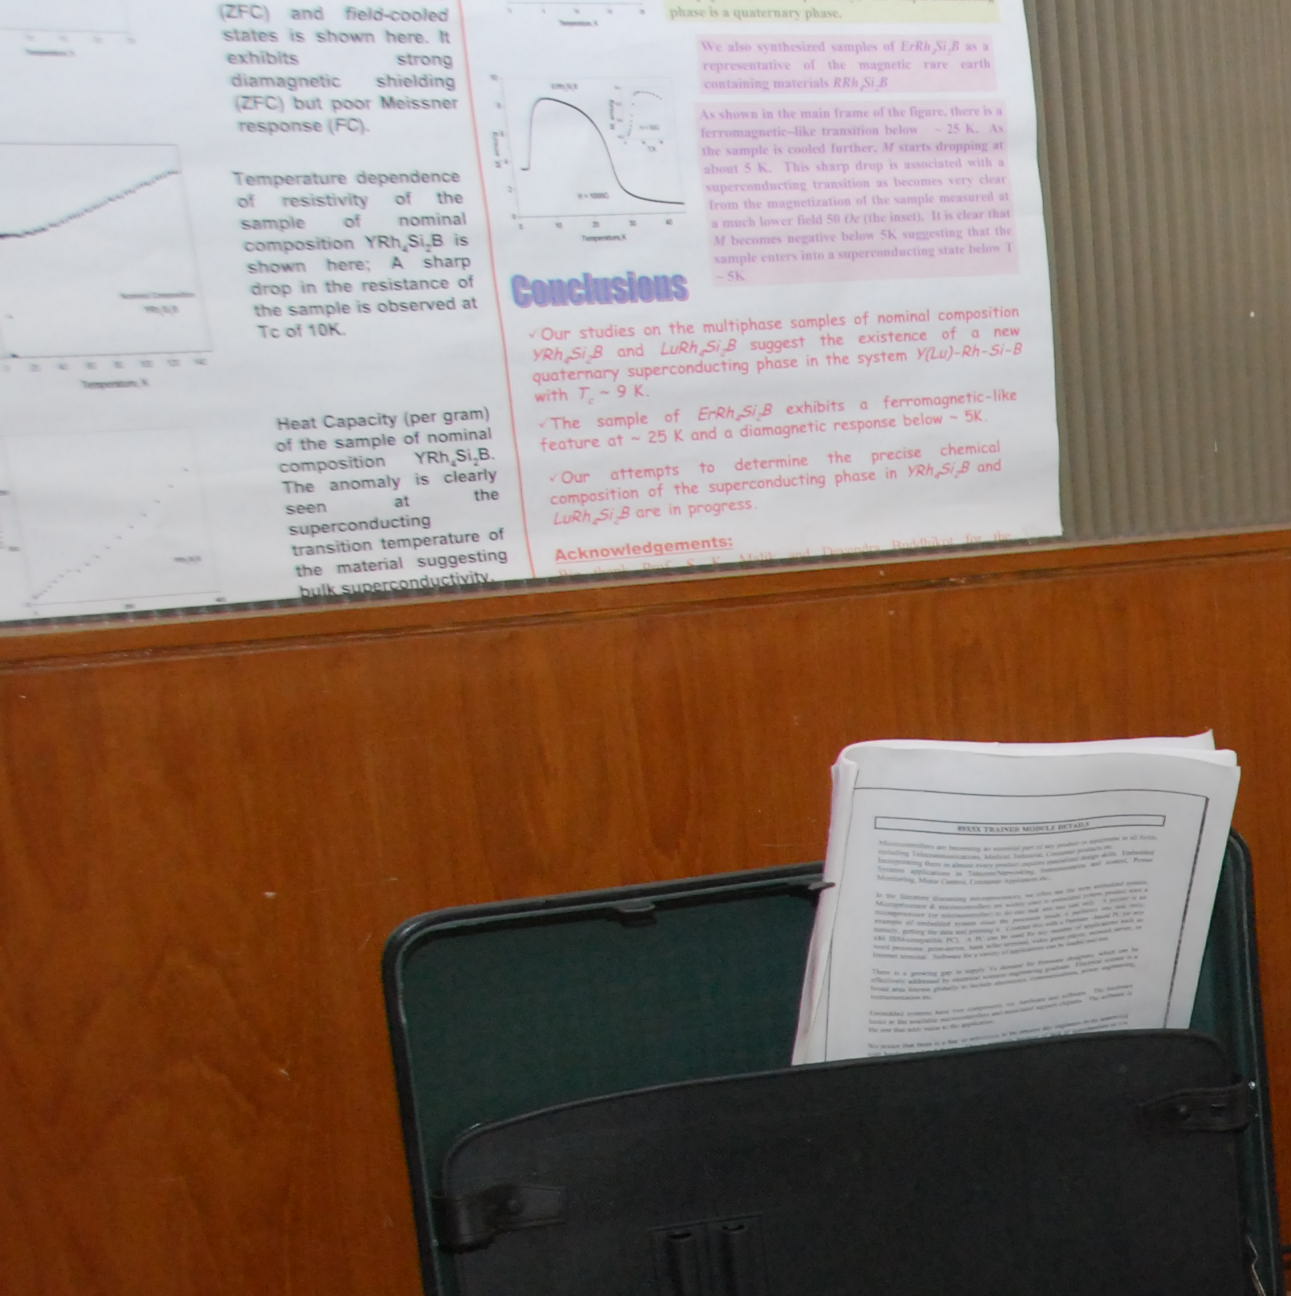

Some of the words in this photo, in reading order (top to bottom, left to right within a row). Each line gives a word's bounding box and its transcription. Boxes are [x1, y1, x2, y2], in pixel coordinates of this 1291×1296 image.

[218, 4, 270, 22] (ZFC)
[290, 6, 325, 21] and
[344, 6, 449, 22] field-cooled
[669, 6, 706, 21] phase
[709, 6, 720, 18] is
[722, 9, 730, 18] a
[733, 8, 801, 21] quaternary
[804, 7, 842, 22] phase.
[222, 29, 279, 43] states
[289, 29, 306, 43] is
[315, 29, 375, 43] shown
[385, 30, 429, 44] here.
[439, 30, 451, 44] It
[226, 50, 300, 66] exhibits
[395, 52, 453, 70] strong
[230, 73, 341, 92] diamagnetic
[376, 74, 456, 92] shielding
[234, 95, 284, 113] (ZFC)
[292, 96, 323, 110] but
[331, 99, 372, 113] poor
[380, 96, 458, 110] Meissner
[237, 121, 322, 136] response
[327, 117, 370, 136] (FC).
[233, 170, 347, 189] Temperature
[355, 170, 461, 187] dependence
[236, 194, 255, 208] of
[282, 193, 368, 210] resistivity
[394, 191, 411, 205] of
[436, 191, 464, 205] the
[240, 216, 306, 232] sample
[343, 214, 361, 228] of
[398, 212, 467, 227] nominal
[244, 237, 355, 254] composition
[454, 233, 469, 246] is
[246, 260, 306, 274] shown
[326, 258, 370, 271] here;
[391, 256, 404, 269] A
[423, 255, 471, 271] sharp
[250, 282, 292, 298] drop
[300, 281, 317, 294] in
[324, 280, 353, 293] the
[361, 278, 450, 292] resistance
[457, 274, 474, 288] of
[511, 271, 689, 308] Conclusions
[254, 304, 282, 317] the
[287, 301, 351, 318] sample
[356, 300, 372, 313] is
[376, 297, 456, 313] observed
[462, 297, 478, 310] at
[258, 324, 280, 339] Tc
[285, 324, 303, 338] of
[308, 322, 346, 336] 10K.
[540, 327, 571, 341] Our
[579, 324, 636, 339] studies
[643, 326, 661, 336] on
[668, 321, 695, 334] the
[703, 317, 783, 335] multiphase
[790, 313, 846, 331] samples
[854, 311, 869, 326] of
[877, 309, 930, 324] nominal
[938, 306, 1019, 324] composition
[617, 343, 645, 358] and
[750, 336, 806, 354] suggest
[820, 333, 844, 347] the
[858, 331, 927, 344] existence
[941, 326, 957, 340] of
[971, 329, 980, 339] a
[994, 328, 1021, 338] new
[532, 368, 620, 386] quaternary
[627, 360, 749, 380] superconducting
[756, 356, 798, 374] phase
[806, 354, 819, 367] in
[825, 352, 850, 366] the
[857, 351, 907, 367] system
[534, 388, 568, 403] with
[617, 384, 627, 398] 9
[633, 384, 649, 397] K.
[276, 417, 318, 430] Heat
[322, 413, 398, 430] Capacity
[403, 412, 437, 427] (per
[443, 406, 490, 425] gram)
[550, 416, 581, 430] The
[597, 411, 648, 429] sample
[664, 408, 680, 423] of
[786, 400, 845, 415] exhibits
[860, 400, 868, 410] a
[883, 389, 1017, 409] ferromagnetic-like
[275, 438, 292, 452] of
[299, 438, 327, 451] the
[334, 434, 396, 450] sample
[403, 431, 420, 445] of
[427, 427, 492, 443] nominal
[539, 437, 600, 452] feature
[607, 434, 624, 447] at
[648, 429, 668, 444] 25
[674, 429, 684, 442] K
[691, 426, 717, 441] and
[724, 429, 733, 439] a
[739, 420, 826, 439] diamagnetic
[833, 418, 896, 433] response
[903, 413, 943, 427] below
[278, 456, 386, 474] composition
[560, 470, 591, 484] Our
[610, 465, 679, 481] attempts
[698, 462, 715, 474] to
[734, 455, 808, 471] determine
[827, 451, 852, 464] the
[871, 448, 922, 465] precise
[940, 440, 1000, 456] chemical
[283, 481, 315, 494] The
[329, 475, 400, 491] anomaly
[415, 473, 430, 485] is
[443, 468, 497, 484] clearly
[550, 488, 639, 507] composition
[648, 483, 664, 498] of
[673, 480, 699, 495] the
[708, 473, 826, 494] superconducting
[834, 469, 876, 487] phase
[885, 467, 898, 480] in
[977, 458, 1002, 472] and
[285, 503, 327, 515] seen
[394, 496, 410, 508] at
[473, 489, 500, 502] the
[636, 507, 661, 519] are
[669, 504, 682, 515] in
[688, 500, 757, 518] progress.
[288, 515, 431, 537] superconducting
[291, 540, 373, 556] transition
[380, 533, 480, 550] temperature
[488, 528, 504, 541] of
[555, 537, 734, 562] Acknowledgements:
[295, 564, 323, 577] the
[336, 556, 403, 574] material
[417, 551, 508, 569] suggesting
